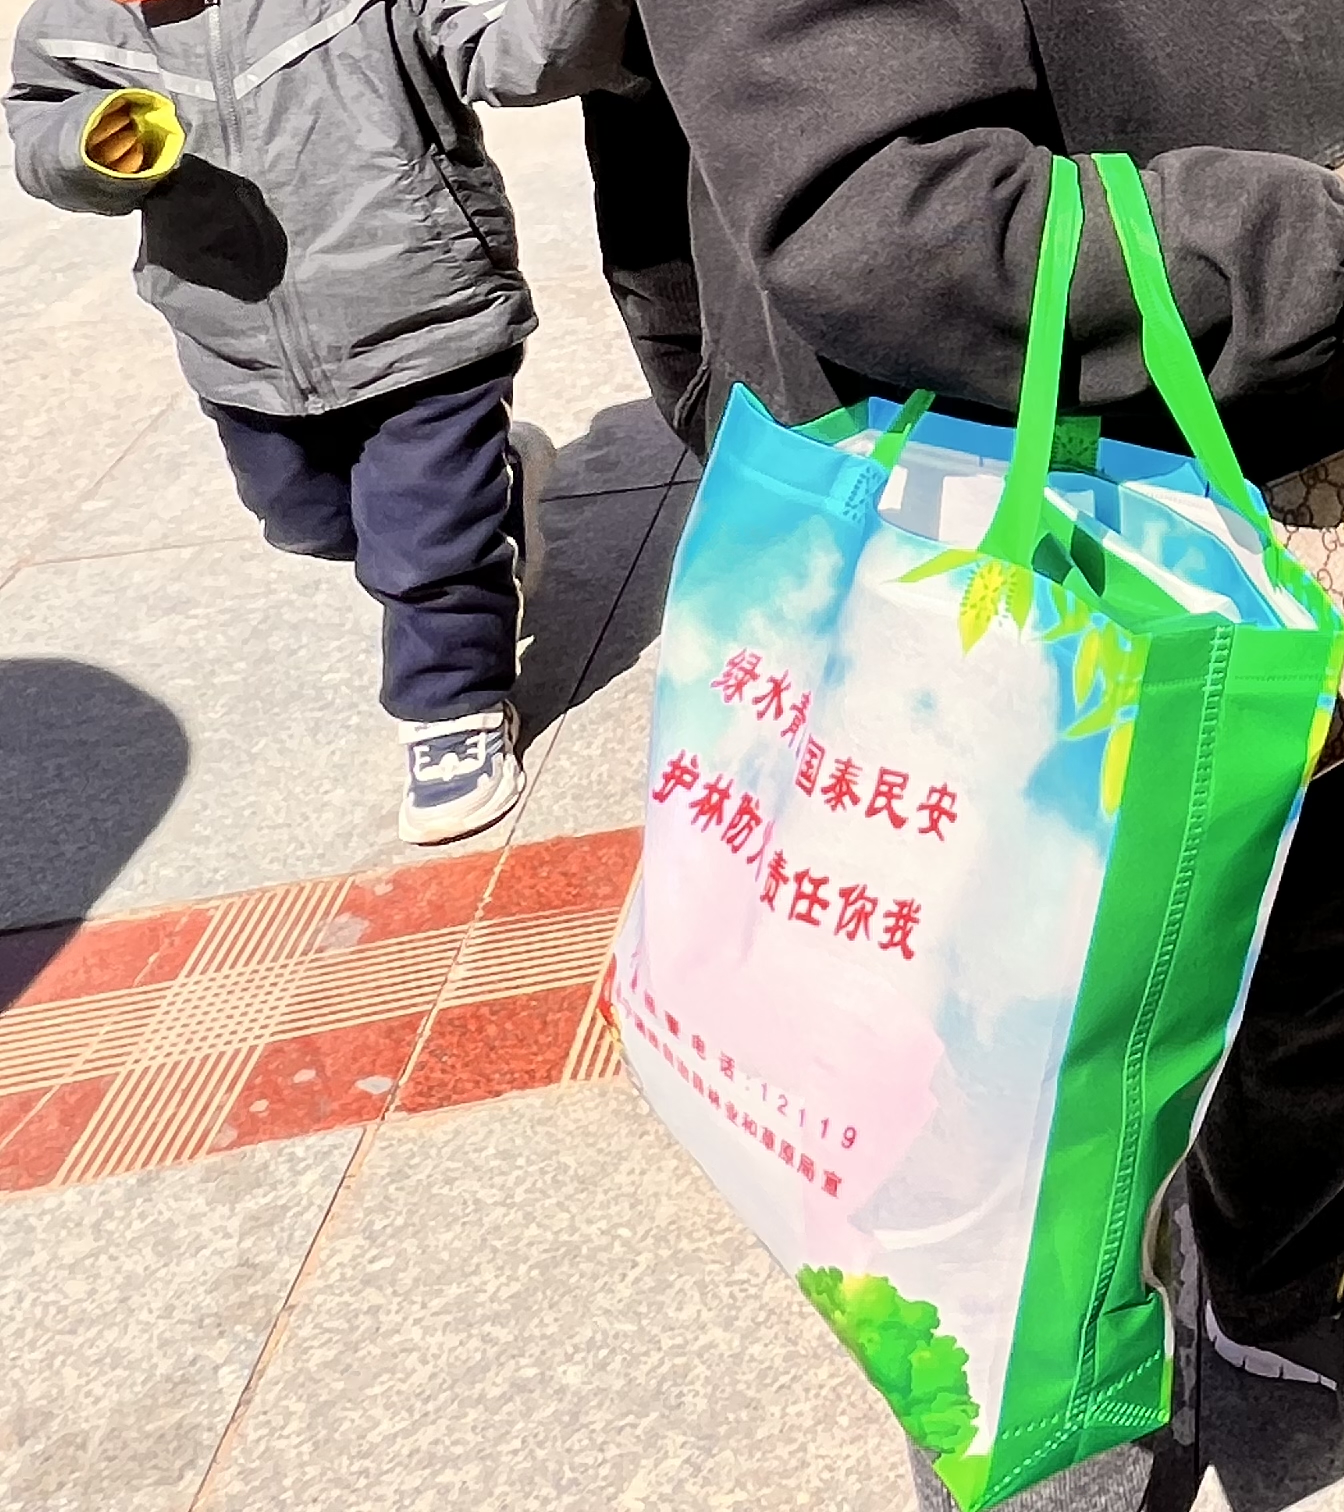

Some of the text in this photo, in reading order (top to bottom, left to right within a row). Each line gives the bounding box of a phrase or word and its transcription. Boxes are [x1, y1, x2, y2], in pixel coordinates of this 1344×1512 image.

[711, 648, 958, 842] 绿水青 国泰民安
[760, 848, 922, 960] 责任你我
